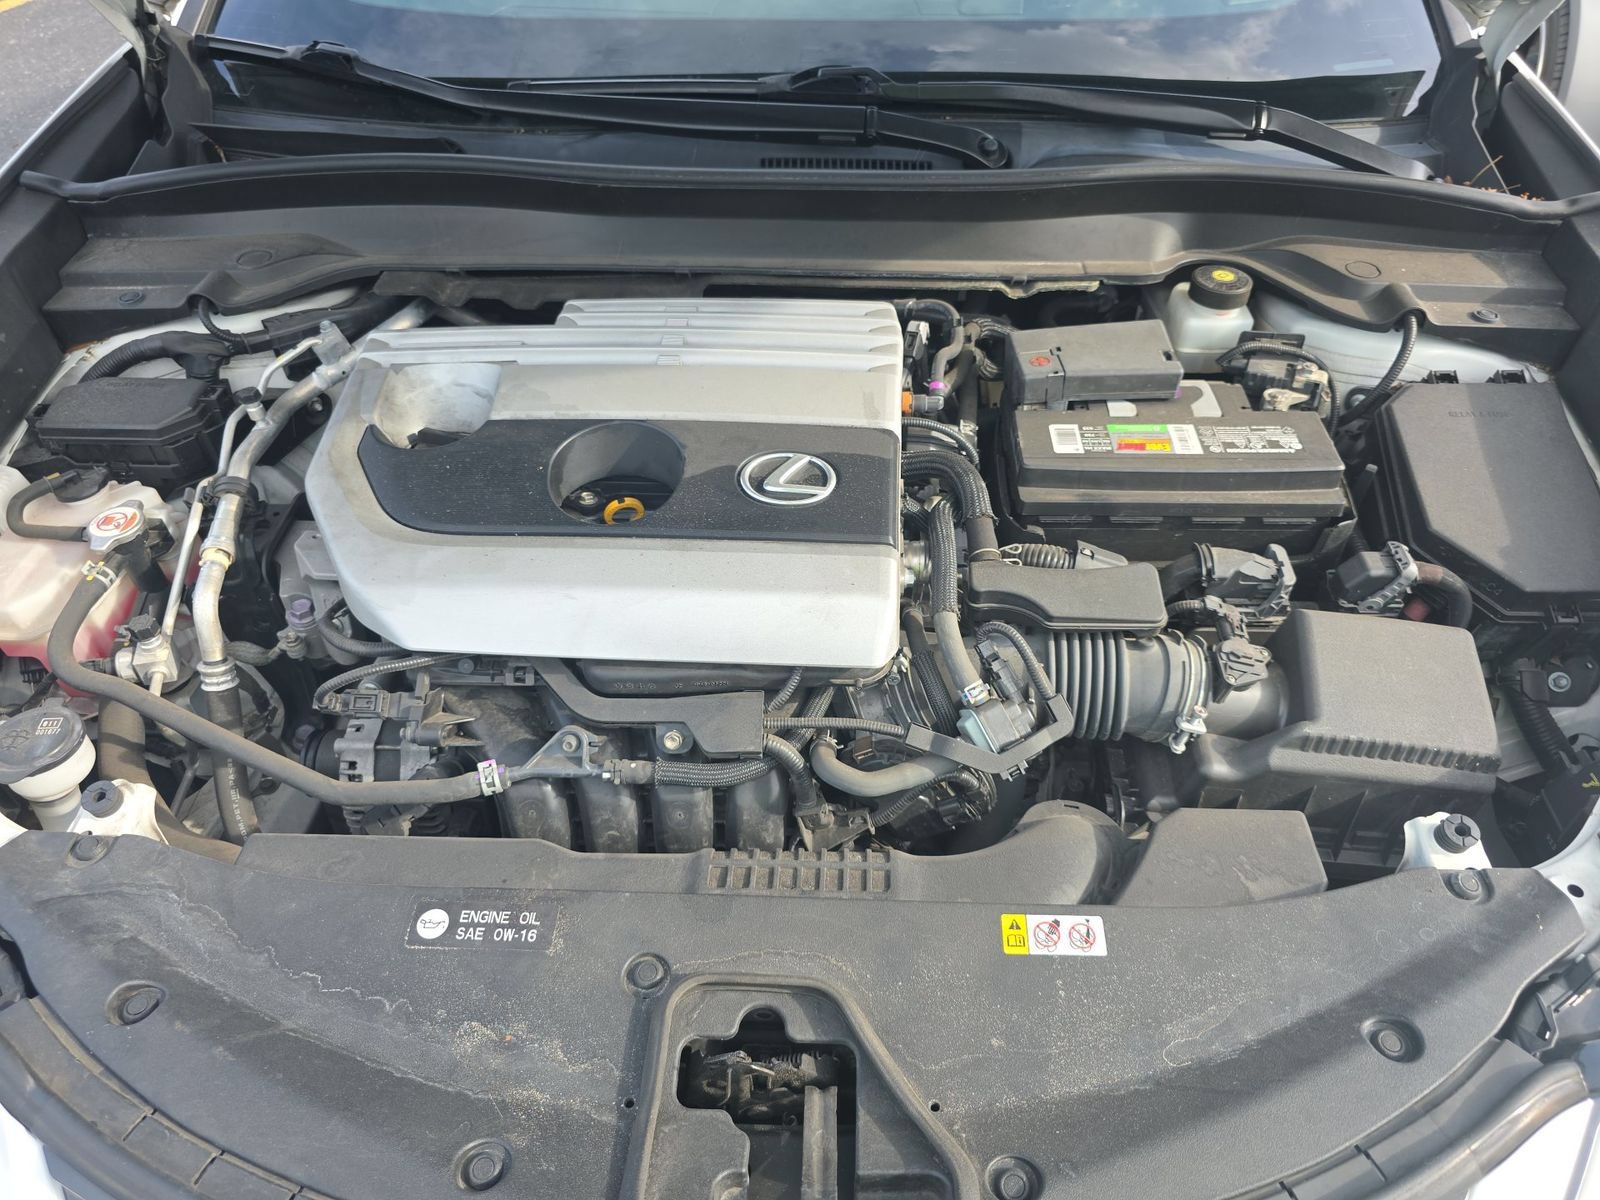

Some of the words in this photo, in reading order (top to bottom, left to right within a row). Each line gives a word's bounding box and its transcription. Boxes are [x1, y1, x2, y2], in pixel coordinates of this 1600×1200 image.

[460, 909, 511, 924] ENGINE
[519, 911, 540, 925] OIL
[455, 927, 485, 940] SAE
[493, 928, 538, 942] 0W-16
